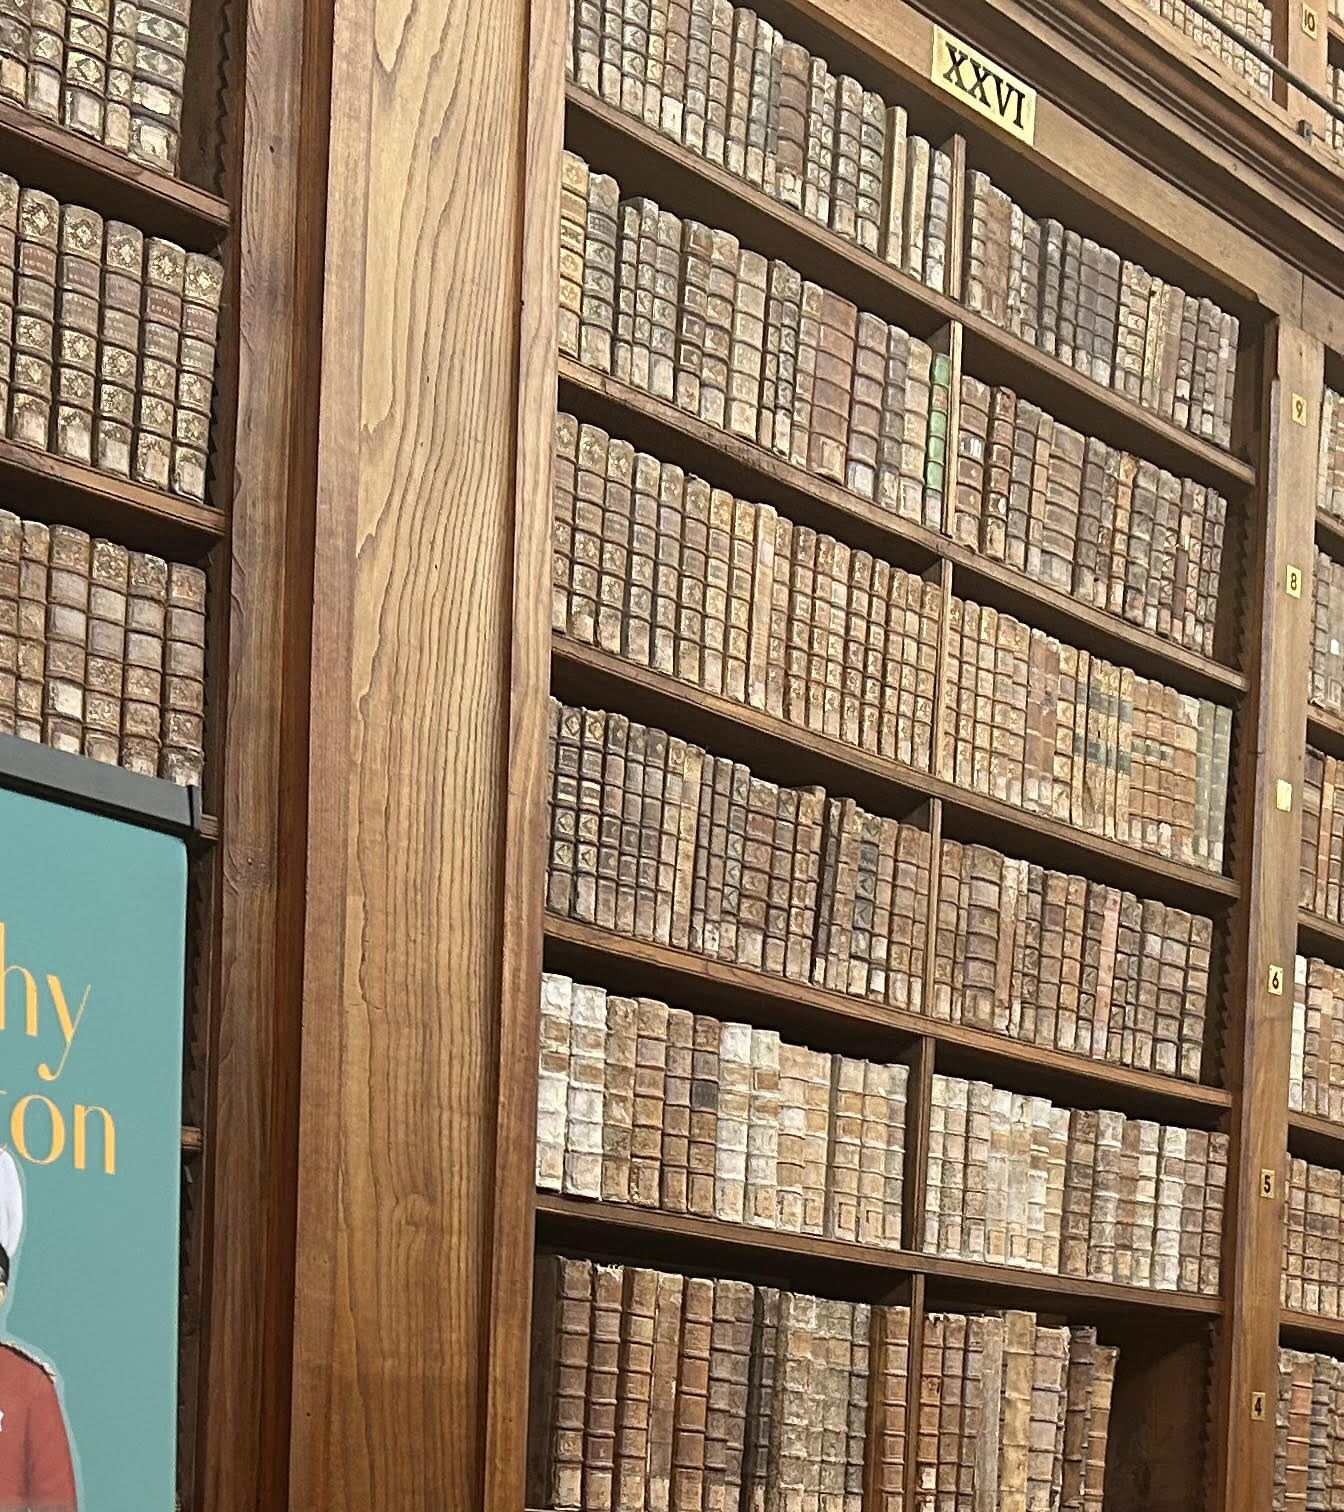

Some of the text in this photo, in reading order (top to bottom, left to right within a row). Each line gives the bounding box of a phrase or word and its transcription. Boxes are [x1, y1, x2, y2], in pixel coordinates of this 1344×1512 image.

[1304, 9, 1315, 32] 10
[943, 40, 1025, 130] XXVI
[1295, 400, 1303, 419] 9
[1290, 572, 1298, 591] 8
[1272, 971, 1279, 989] 6
[1263, 1174, 1271, 1194] 5
[1255, 1396, 1262, 1416] 4
